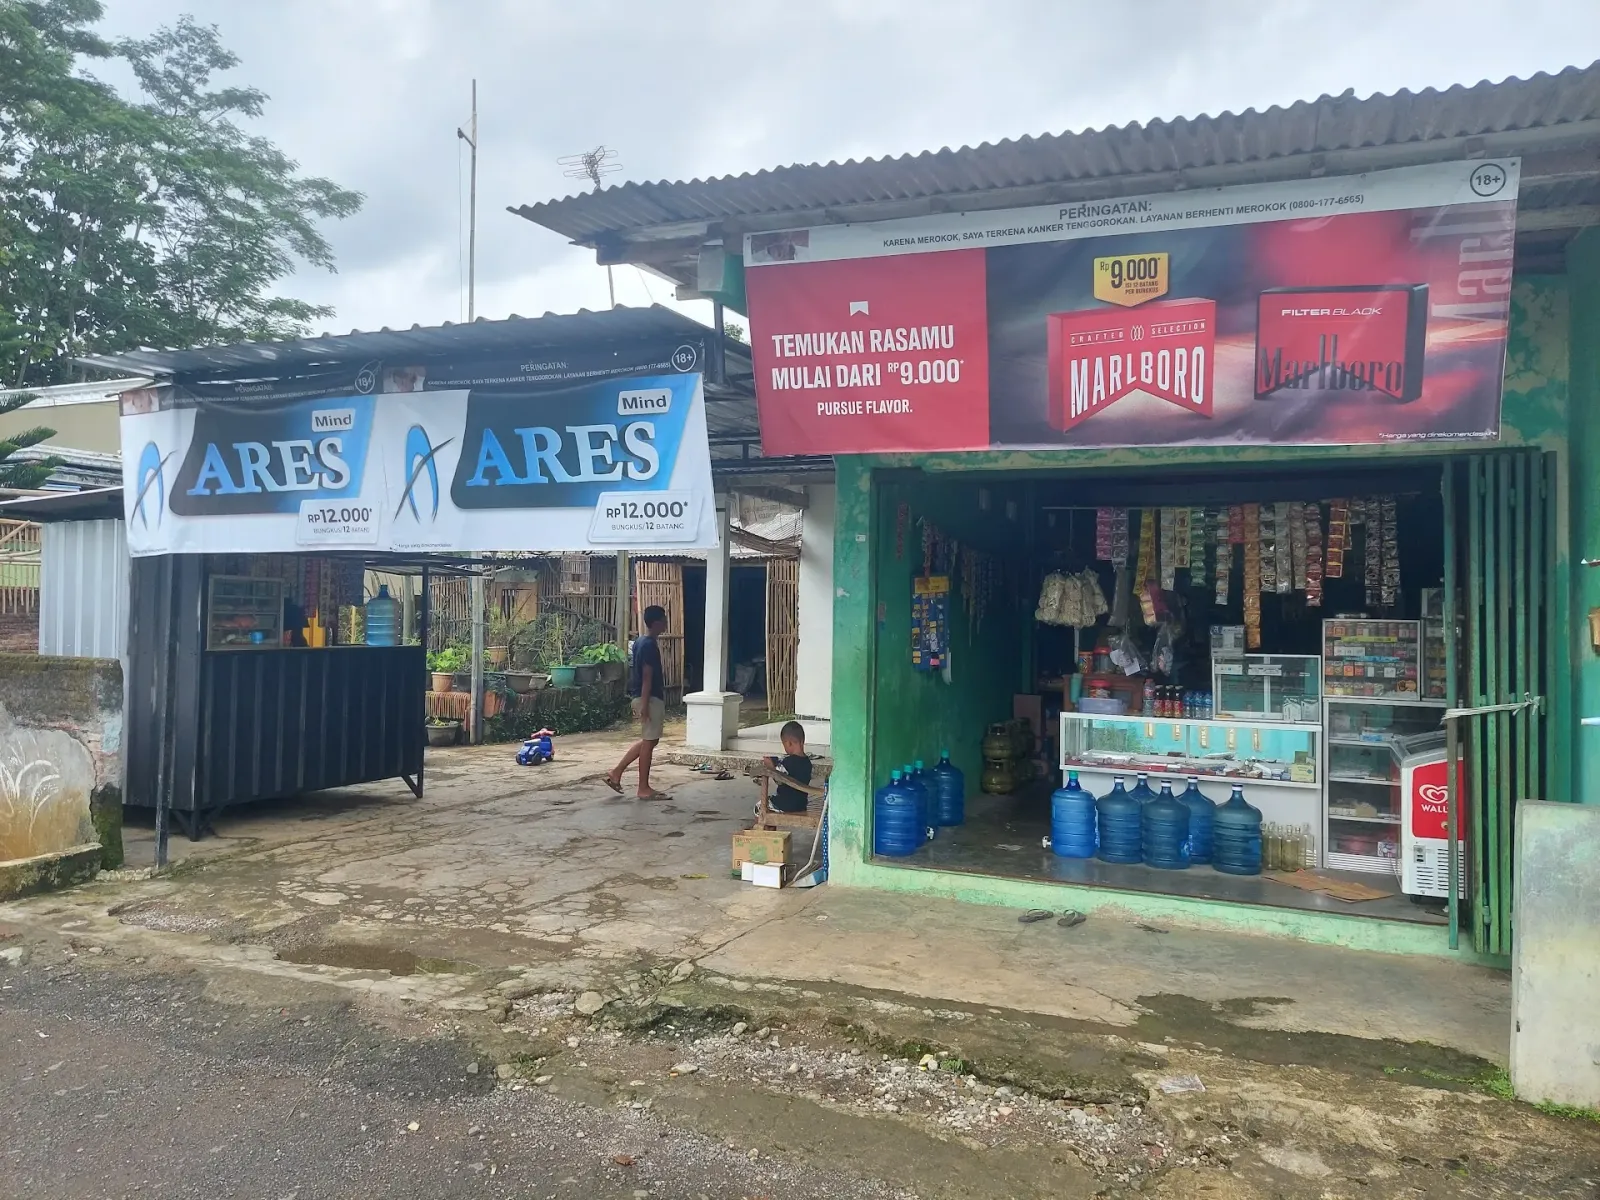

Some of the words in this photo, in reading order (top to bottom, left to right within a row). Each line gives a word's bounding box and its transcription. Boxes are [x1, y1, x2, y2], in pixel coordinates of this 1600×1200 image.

[1475, 174, 1501, 186] 18+
[883, 238, 916, 247] KARENA
[917, 234, 961, 244] MEROKOK,
[963, 232, 984, 240] SAYA
[985, 228, 1026, 238] TERKENA
[1027, 224, 1064, 234] KANKER
[1066, 216, 1139, 230] TENGGOROKAN.
[1140, 212, 1183, 223] LAYANAN
[1186, 207, 1234, 219] BERHENTI
[1236, 202, 1287, 214] MEROKOK
[1289, 194, 1364, 211] (0800-177-6565)
[1059, 200, 1152, 220] PERINGATAN:
[1281, 309, 1331, 317] FILTER
[1332, 307, 1383, 317] BLACK
[772, 330, 865, 357] TEMUKAN
[869, 325, 955, 353] RASAMU
[1071, 331, 1124, 344] CRAFTED
[1151, 322, 1206, 335] SELECTION
[675, 353, 693, 364] 18+
[1260, 333, 1403, 392] Marlboro
[772, 365, 831, 390] MULAI
[836, 363, 881, 388] DARI
[1071, 346, 1205, 419] MARLBORO
[622, 394, 667, 411] Mind
[817, 401, 863, 416] PURSUE
[866, 398, 913, 415] FLAVOR.
[315, 414, 352, 429] Mind
[466, 421, 660, 487] ARES
[186, 437, 351, 496] ARES
